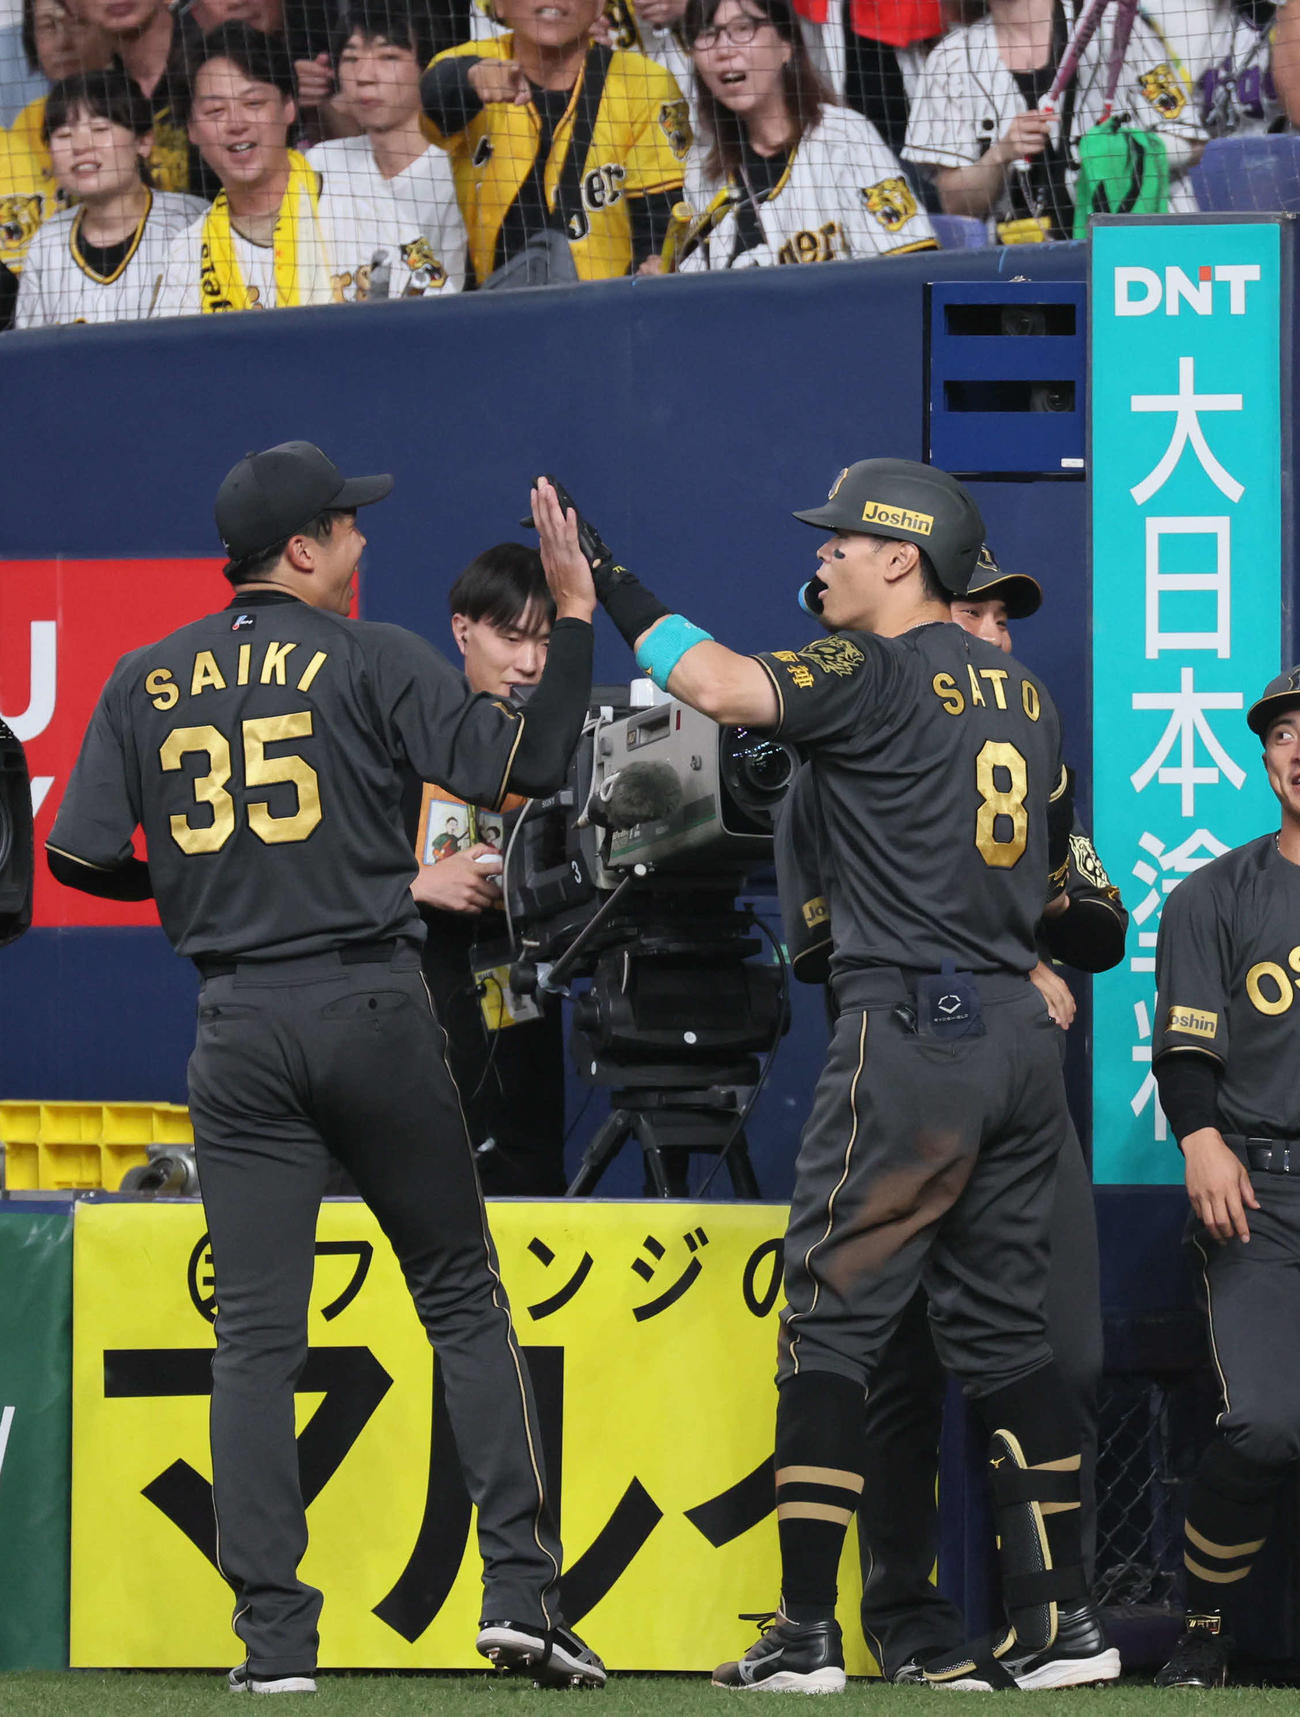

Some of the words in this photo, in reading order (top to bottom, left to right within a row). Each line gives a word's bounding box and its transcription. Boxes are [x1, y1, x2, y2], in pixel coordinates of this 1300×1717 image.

[1114, 264, 1261, 317] DNT
[865, 504, 931, 532] Joshin
[144, 641, 328, 711] SAIKI
[931, 663, 1041, 723] SATO
[158, 710, 323, 856] 35
[975, 739, 1030, 869] 8
[571, 860, 582, 884] 3
[1170, 1012, 1216, 1033] oshin
